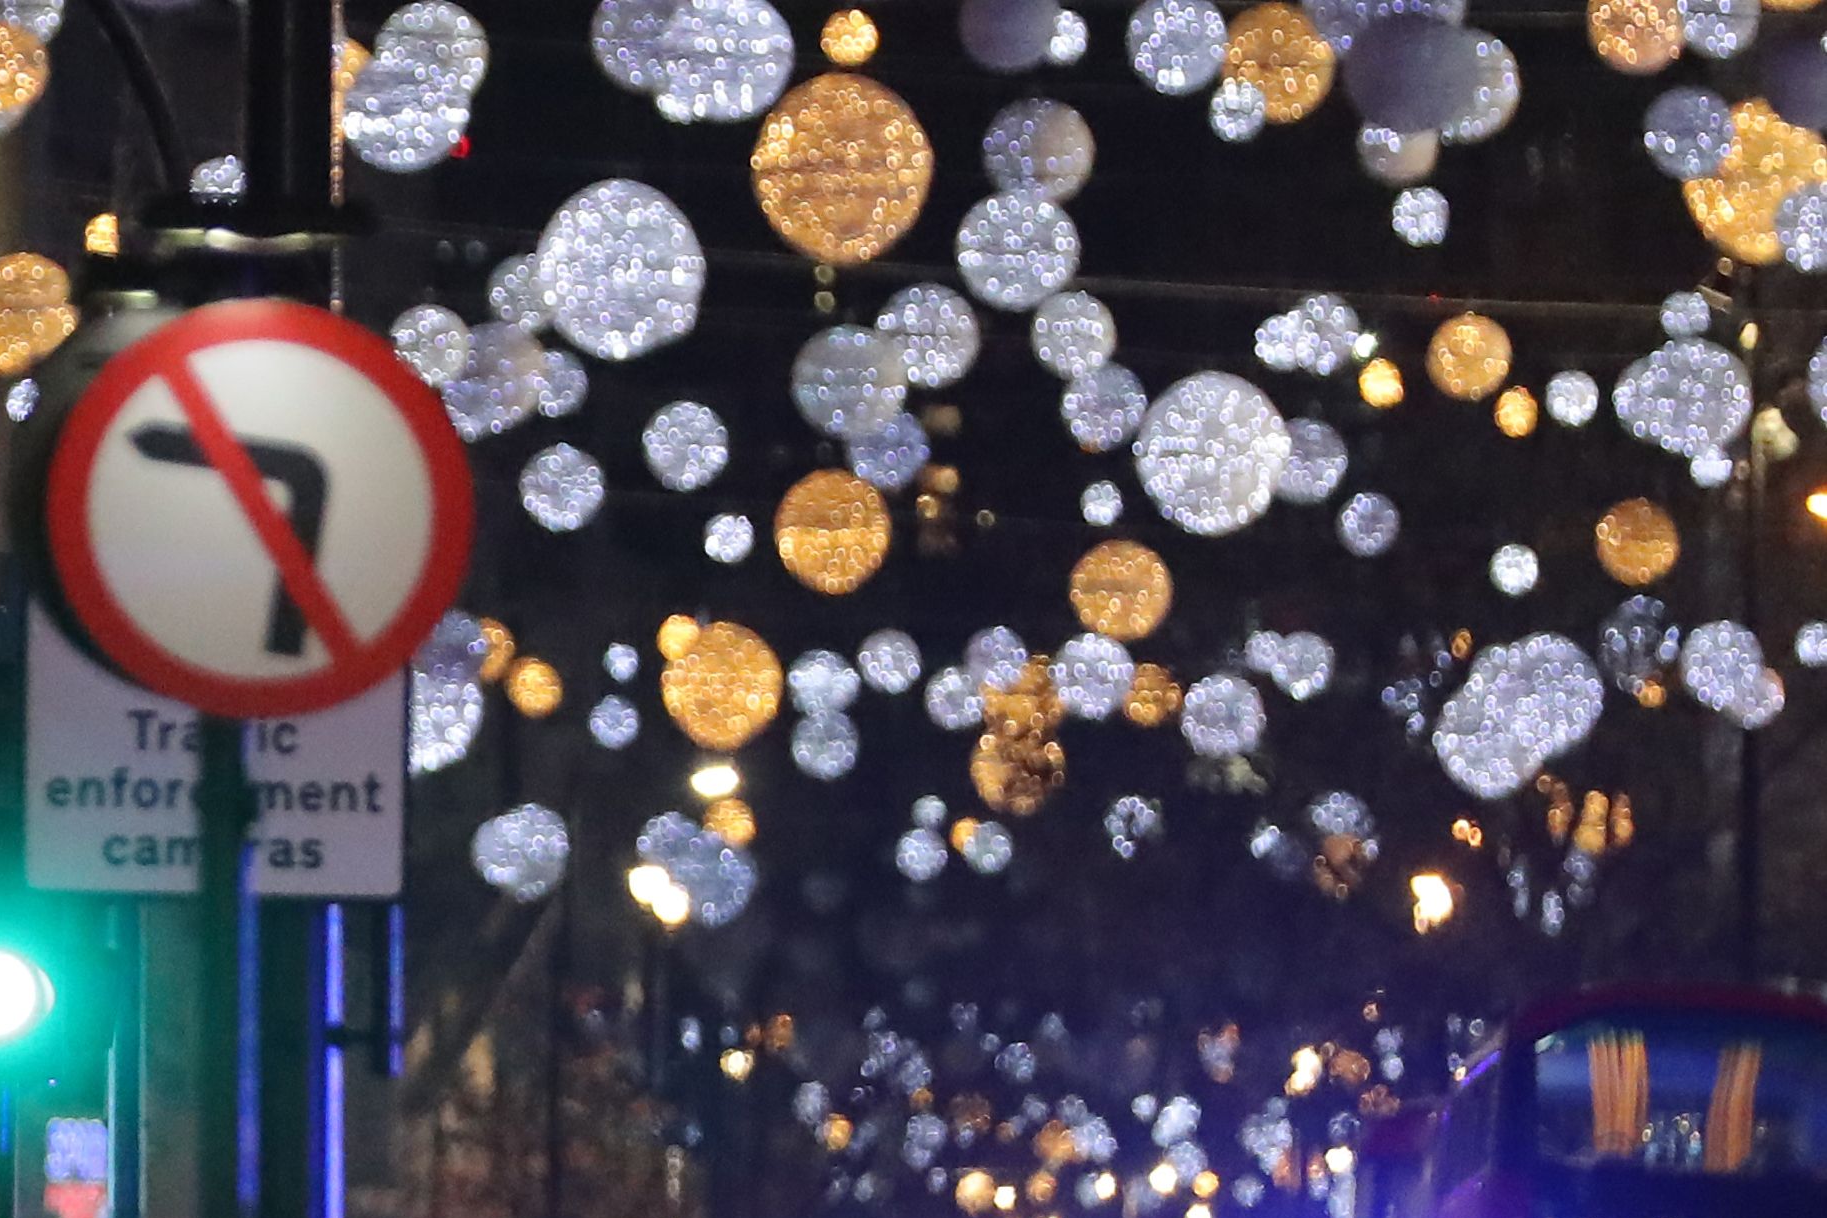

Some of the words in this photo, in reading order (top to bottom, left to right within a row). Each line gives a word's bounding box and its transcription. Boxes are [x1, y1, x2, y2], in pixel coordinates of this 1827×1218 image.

[126, 709, 299, 755] Traic
[45, 766, 382, 812] enforment
[101, 833, 325, 870] camas
